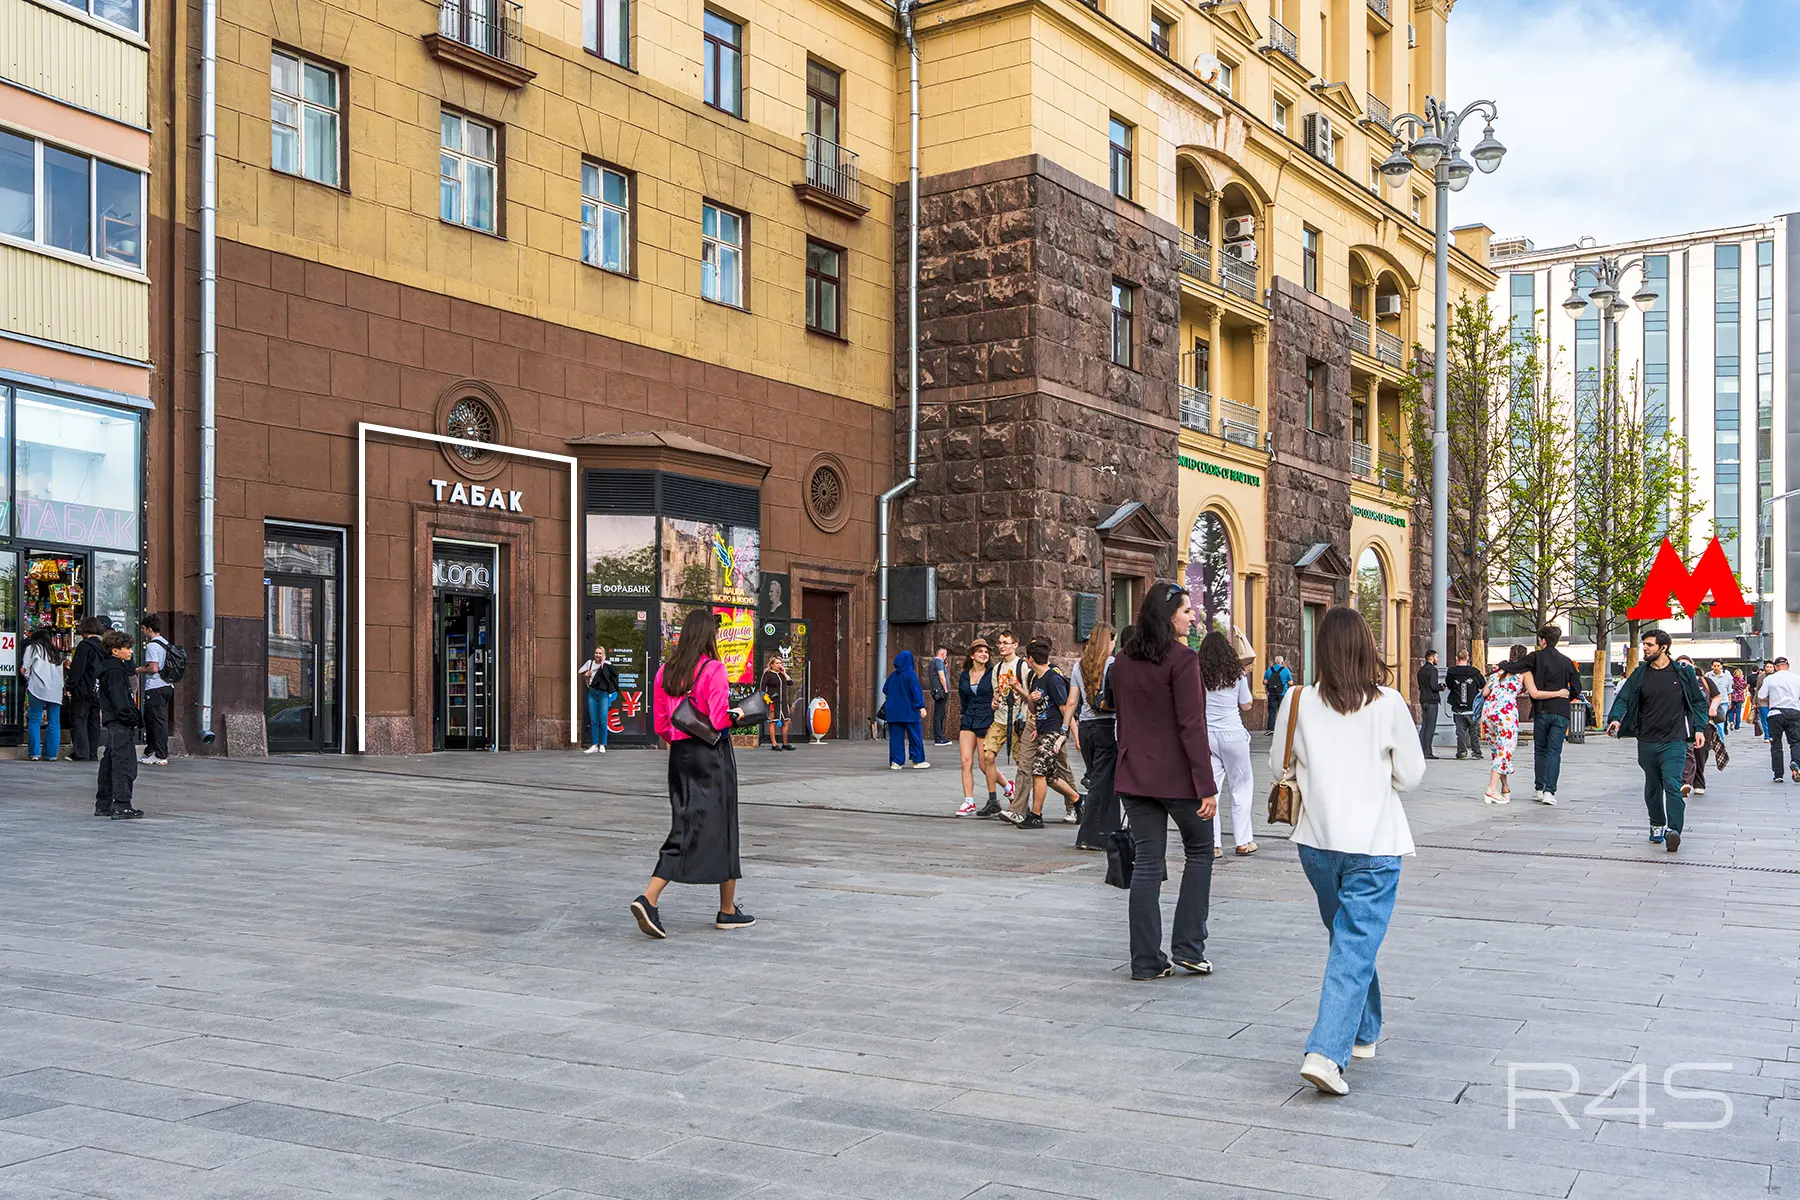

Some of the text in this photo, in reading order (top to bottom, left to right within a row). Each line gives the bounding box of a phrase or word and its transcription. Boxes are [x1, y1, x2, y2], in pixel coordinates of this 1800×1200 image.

[1197, 460, 1222, 477] COLORS
[429, 479, 523, 512] ТАБАК
[15, 497, 137, 548] ТАБАК
[603, 584, 651, 594] ФОРАБАНК
[2, 636, 15, 650] 24
